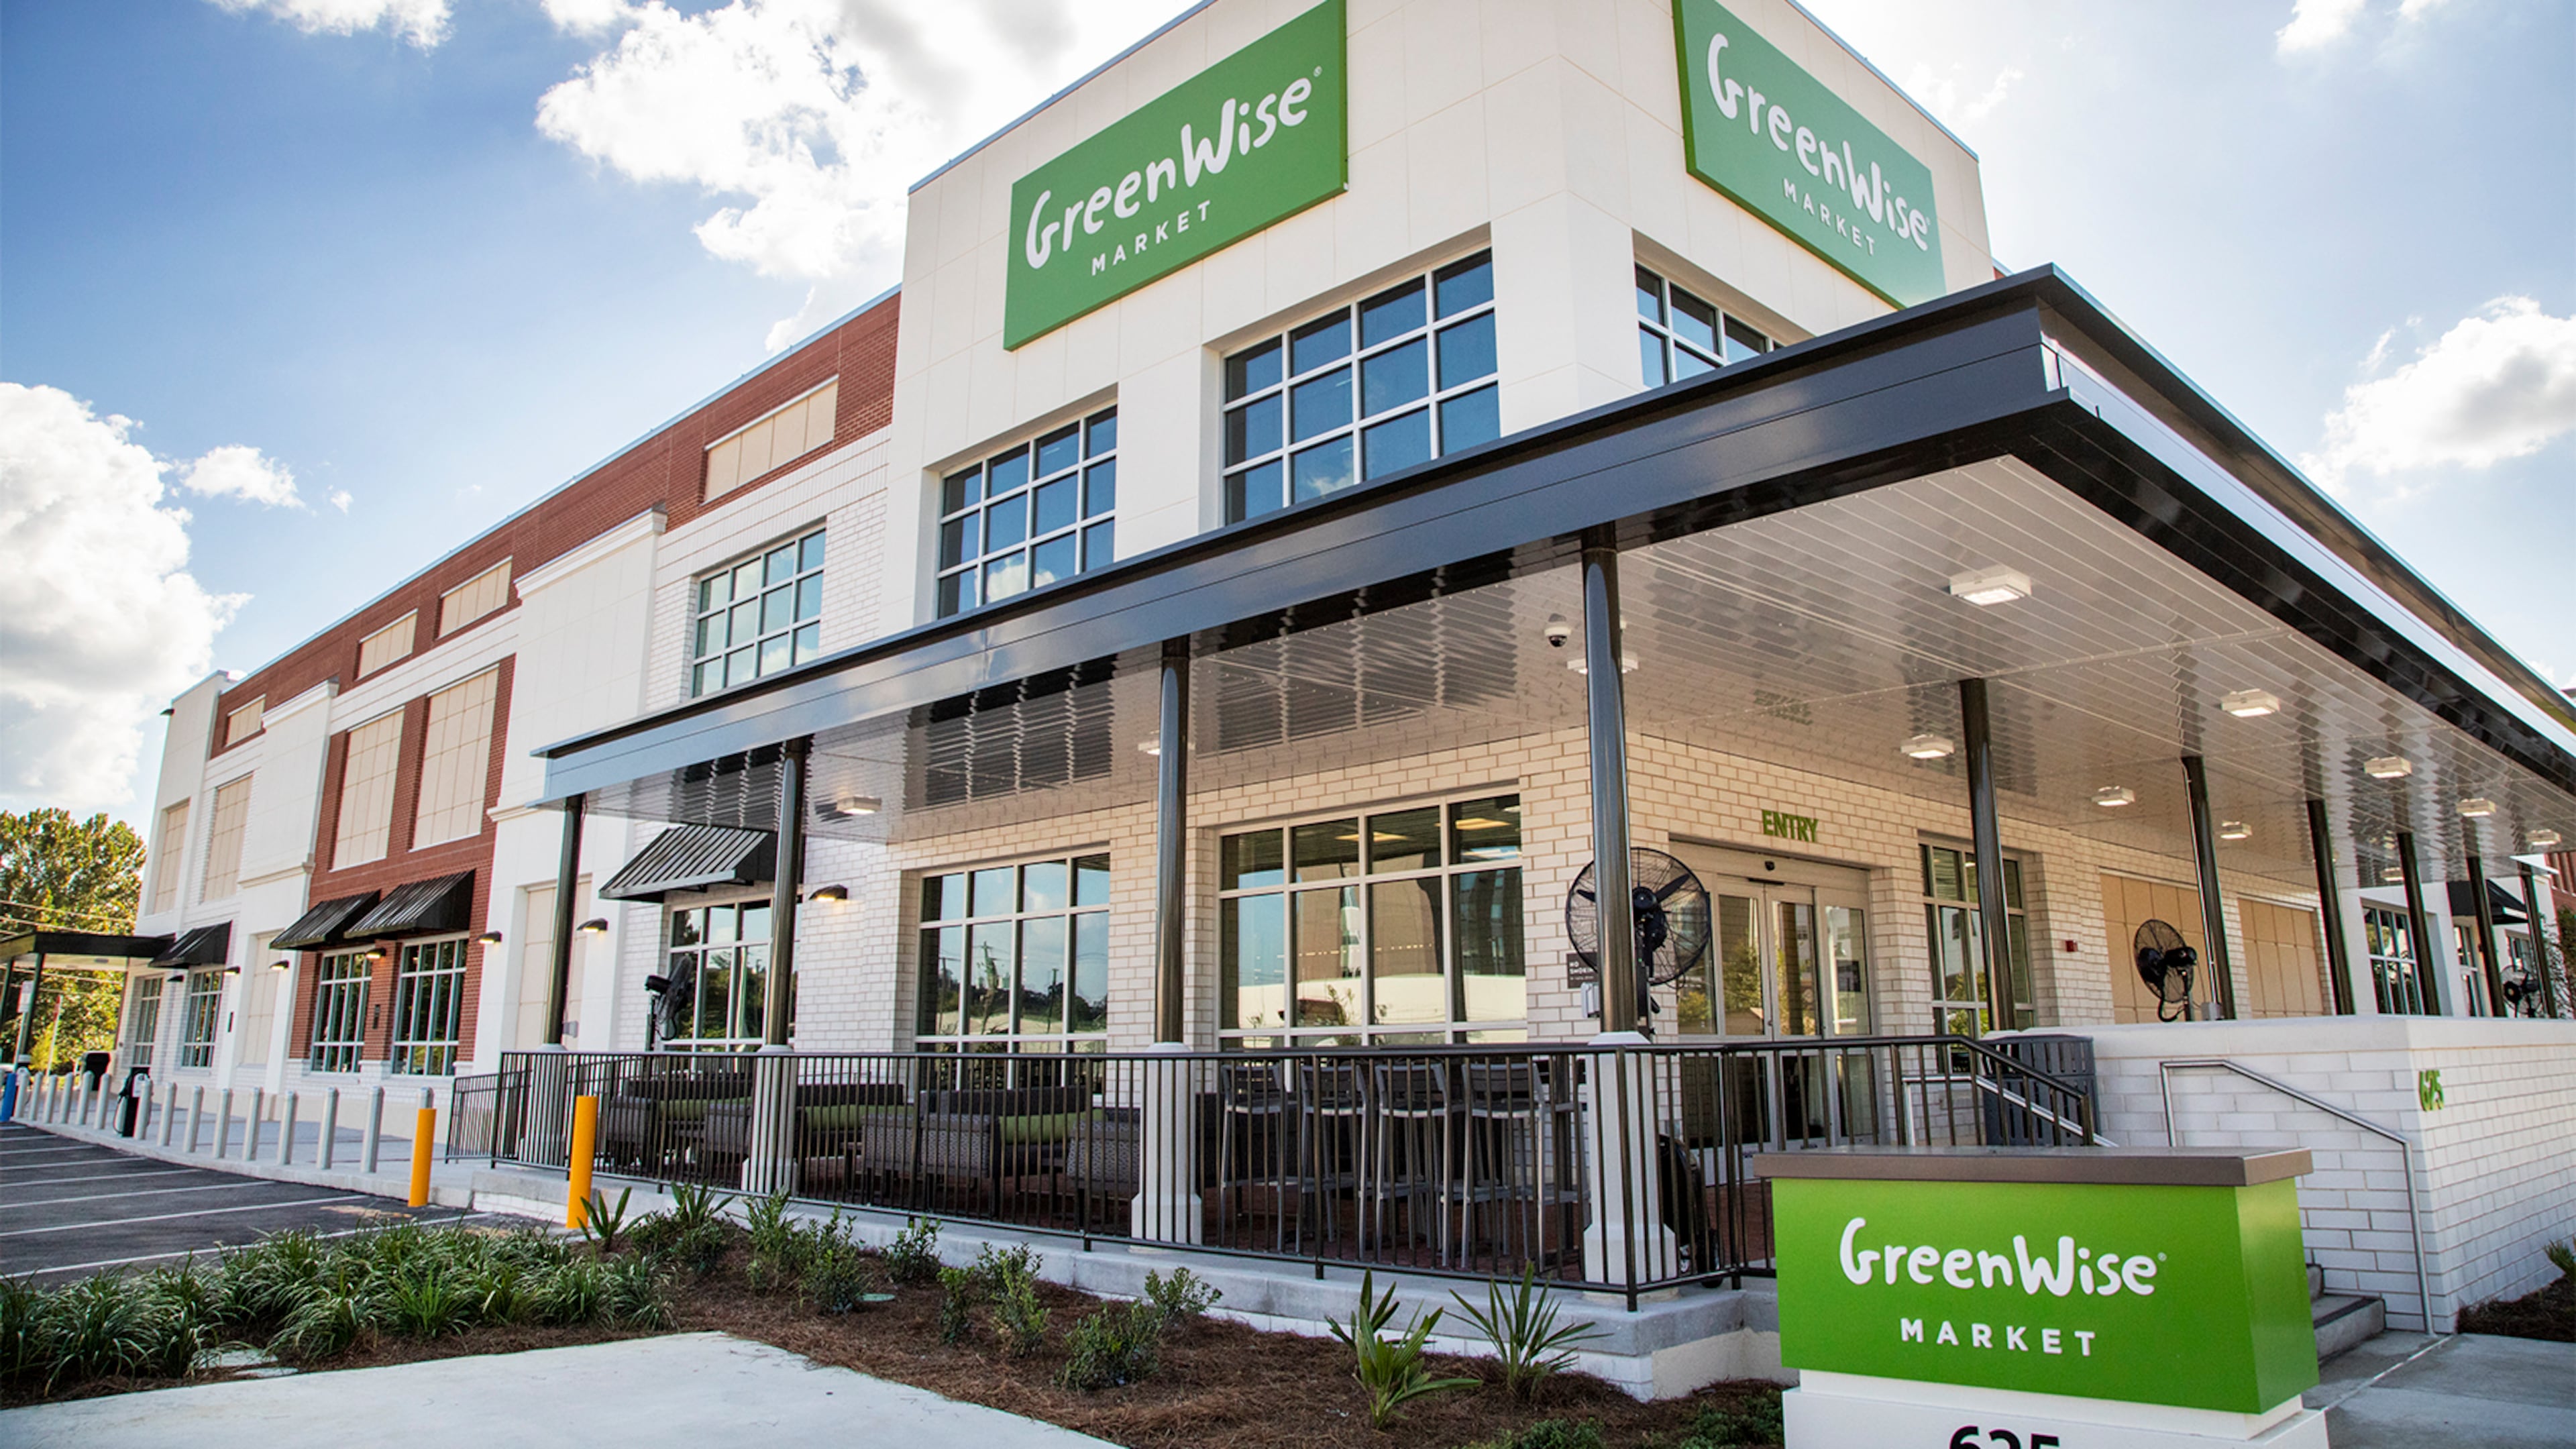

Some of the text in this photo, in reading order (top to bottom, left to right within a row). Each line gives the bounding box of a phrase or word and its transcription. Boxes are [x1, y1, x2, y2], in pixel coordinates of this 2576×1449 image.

[1025, 77, 1312, 269] GreenWise
[1707, 33, 1929, 252] GreenWise
[1091, 200, 1211, 276] MARKET
[1783, 178, 1876, 256] MARKET
[1762, 809, 1819, 843] ENTRY
[1839, 1217, 2157, 1297] GreenWise
[1900, 1318, 2095, 1356] MARKET
